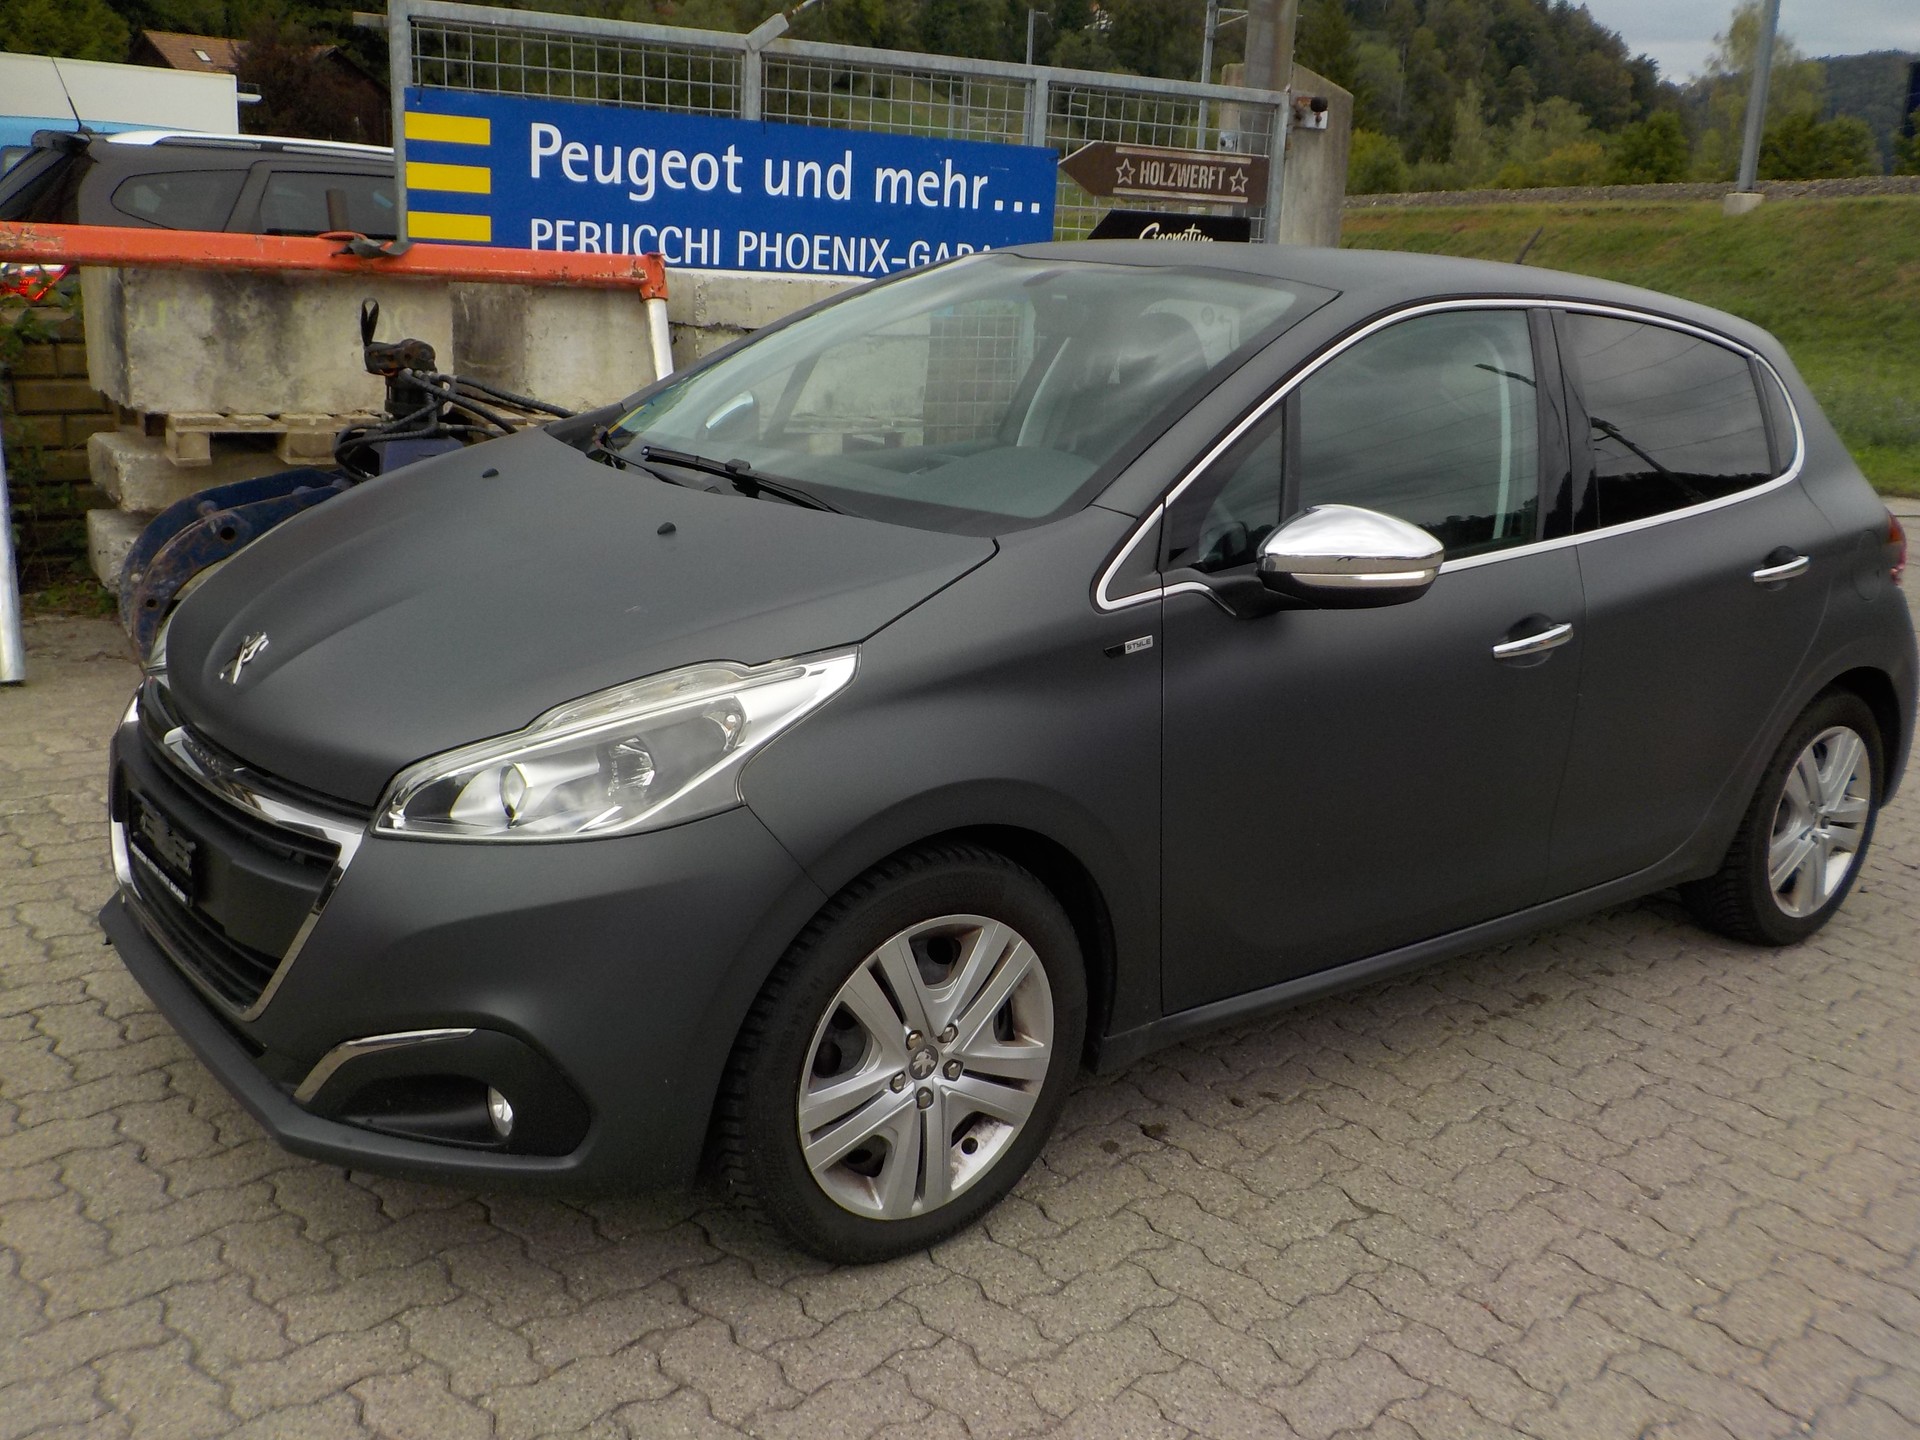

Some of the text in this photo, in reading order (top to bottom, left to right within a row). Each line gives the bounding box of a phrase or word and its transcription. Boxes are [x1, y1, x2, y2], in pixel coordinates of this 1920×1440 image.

[531, 122, 1040, 214] Peugeot und mehr...
[1139, 161, 1226, 190] HOLZWERFT
[531, 218, 991, 273] PERUCCHI PHOENIX-GA
[1127, 638, 1151, 650] STYLE
